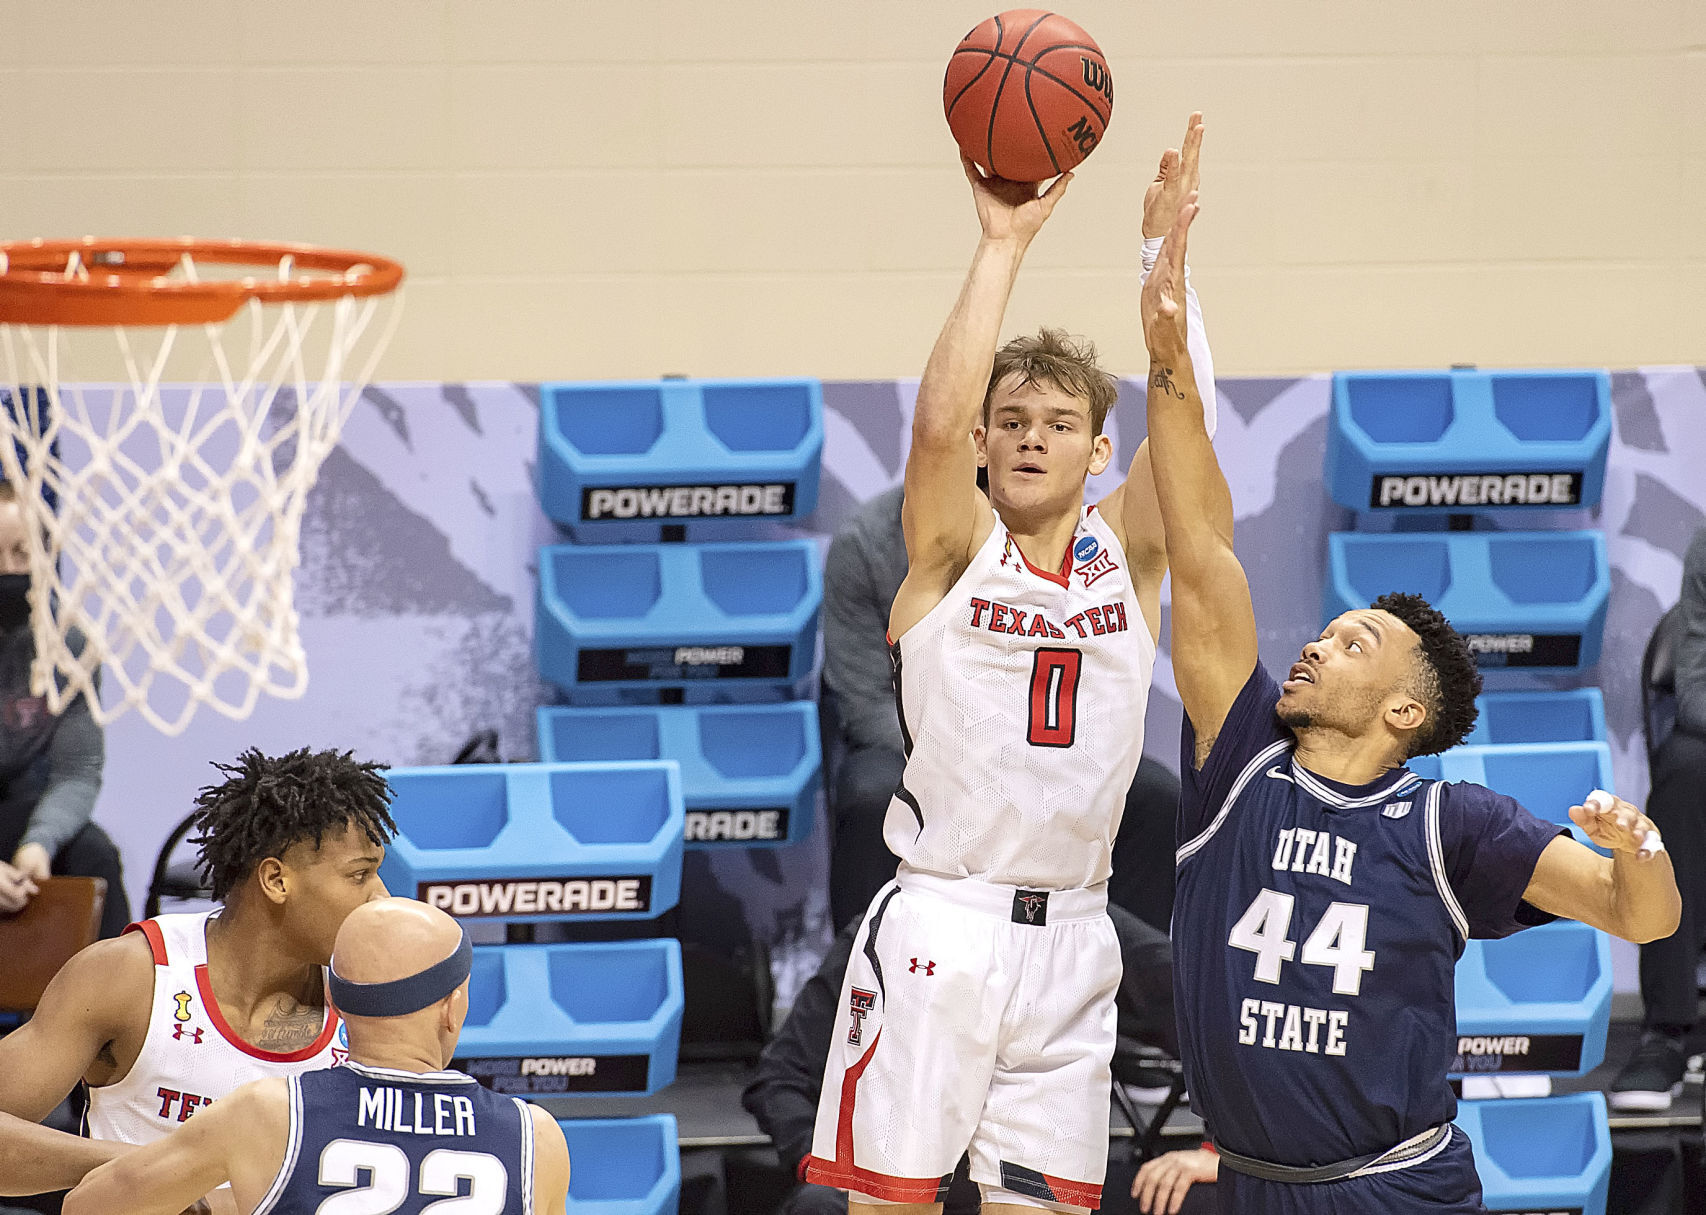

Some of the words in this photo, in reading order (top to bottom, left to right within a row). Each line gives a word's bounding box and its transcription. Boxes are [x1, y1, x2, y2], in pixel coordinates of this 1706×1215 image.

[589, 484, 786, 518] POWERADE
[1379, 474, 1573, 506] POWERADE
[1078, 541, 1098, 559] NCAA
[970, 597, 1065, 639] TEXAS
[1063, 602, 1128, 638] TECH
[674, 646, 744, 665] POWER
[1026, 646, 1083, 748] 0
[1272, 827, 1357, 886] UTAH
[427, 879, 641, 915] POWERADE
[1228, 887, 1376, 996] 44
[1238, 998, 1349, 1057] STATE
[1457, 1036, 1530, 1055] POWER
[521, 1057, 597, 1076] POWER
[157, 1086, 213, 1122] TE
[358, 1087, 476, 1136] MILLER
[317, 1138, 508, 1215] 22
